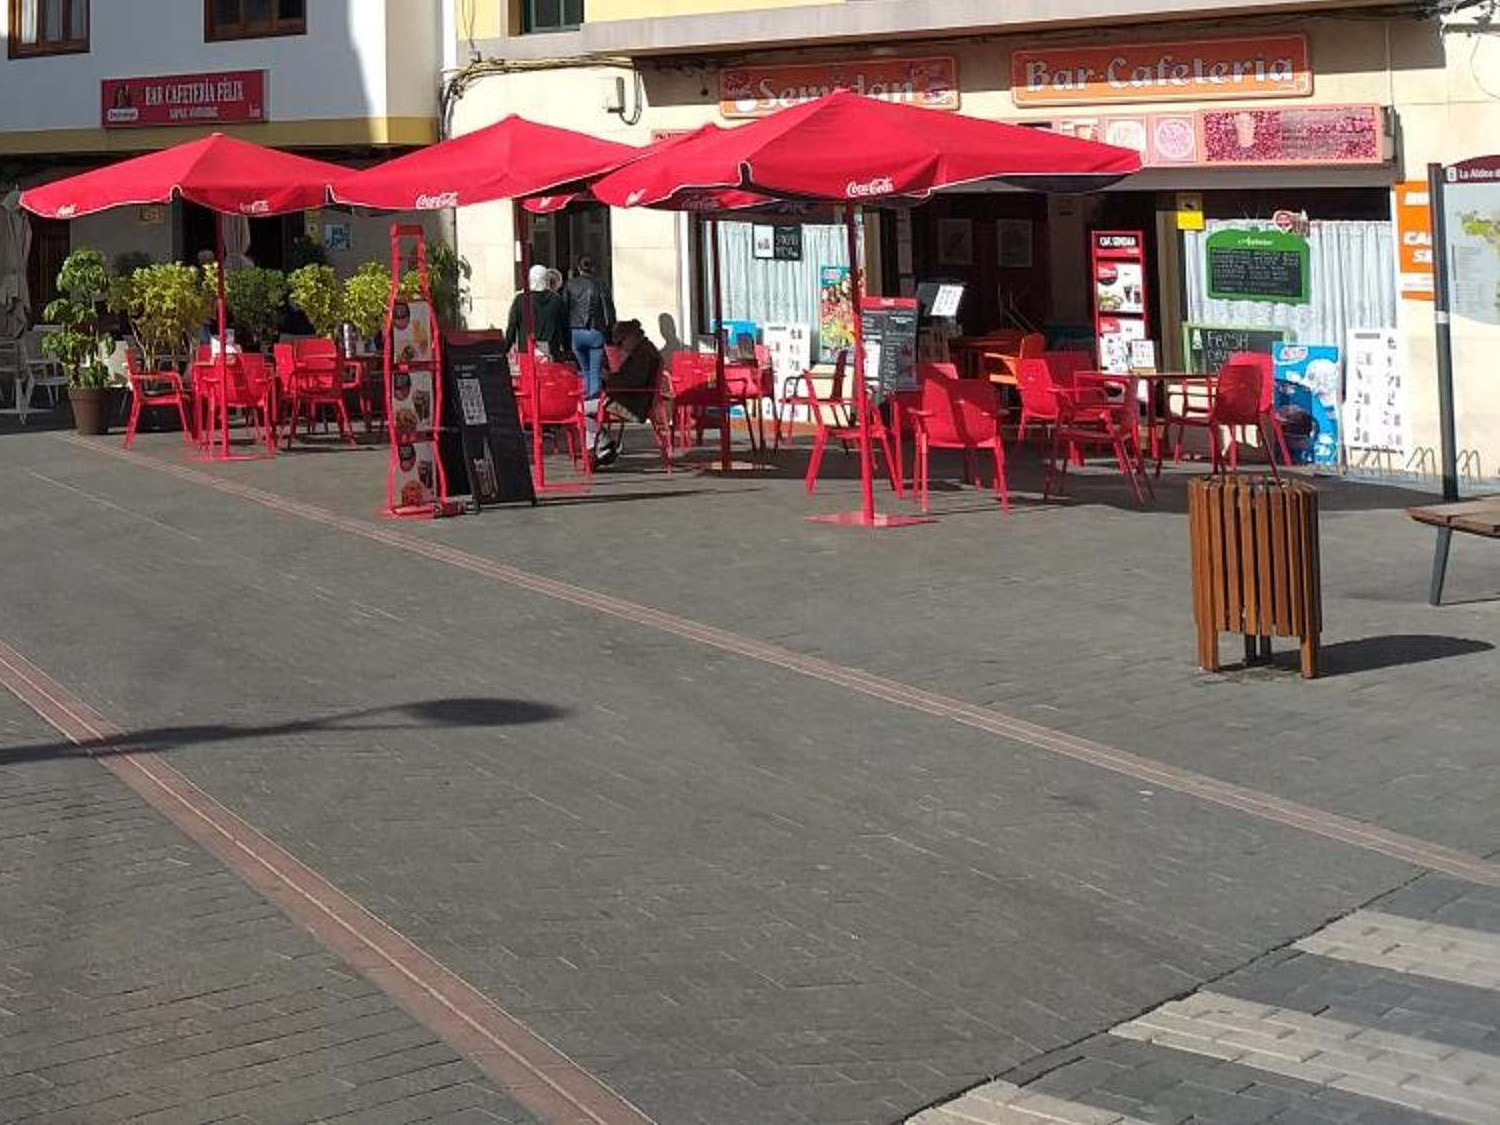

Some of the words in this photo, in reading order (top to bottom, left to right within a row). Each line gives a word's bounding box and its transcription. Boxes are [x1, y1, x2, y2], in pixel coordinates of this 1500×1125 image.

[1026, 59, 1094, 93] Bar
[1106, 53, 1294, 89] Cafeteria
[846, 177, 894, 198] Coca-Cola
